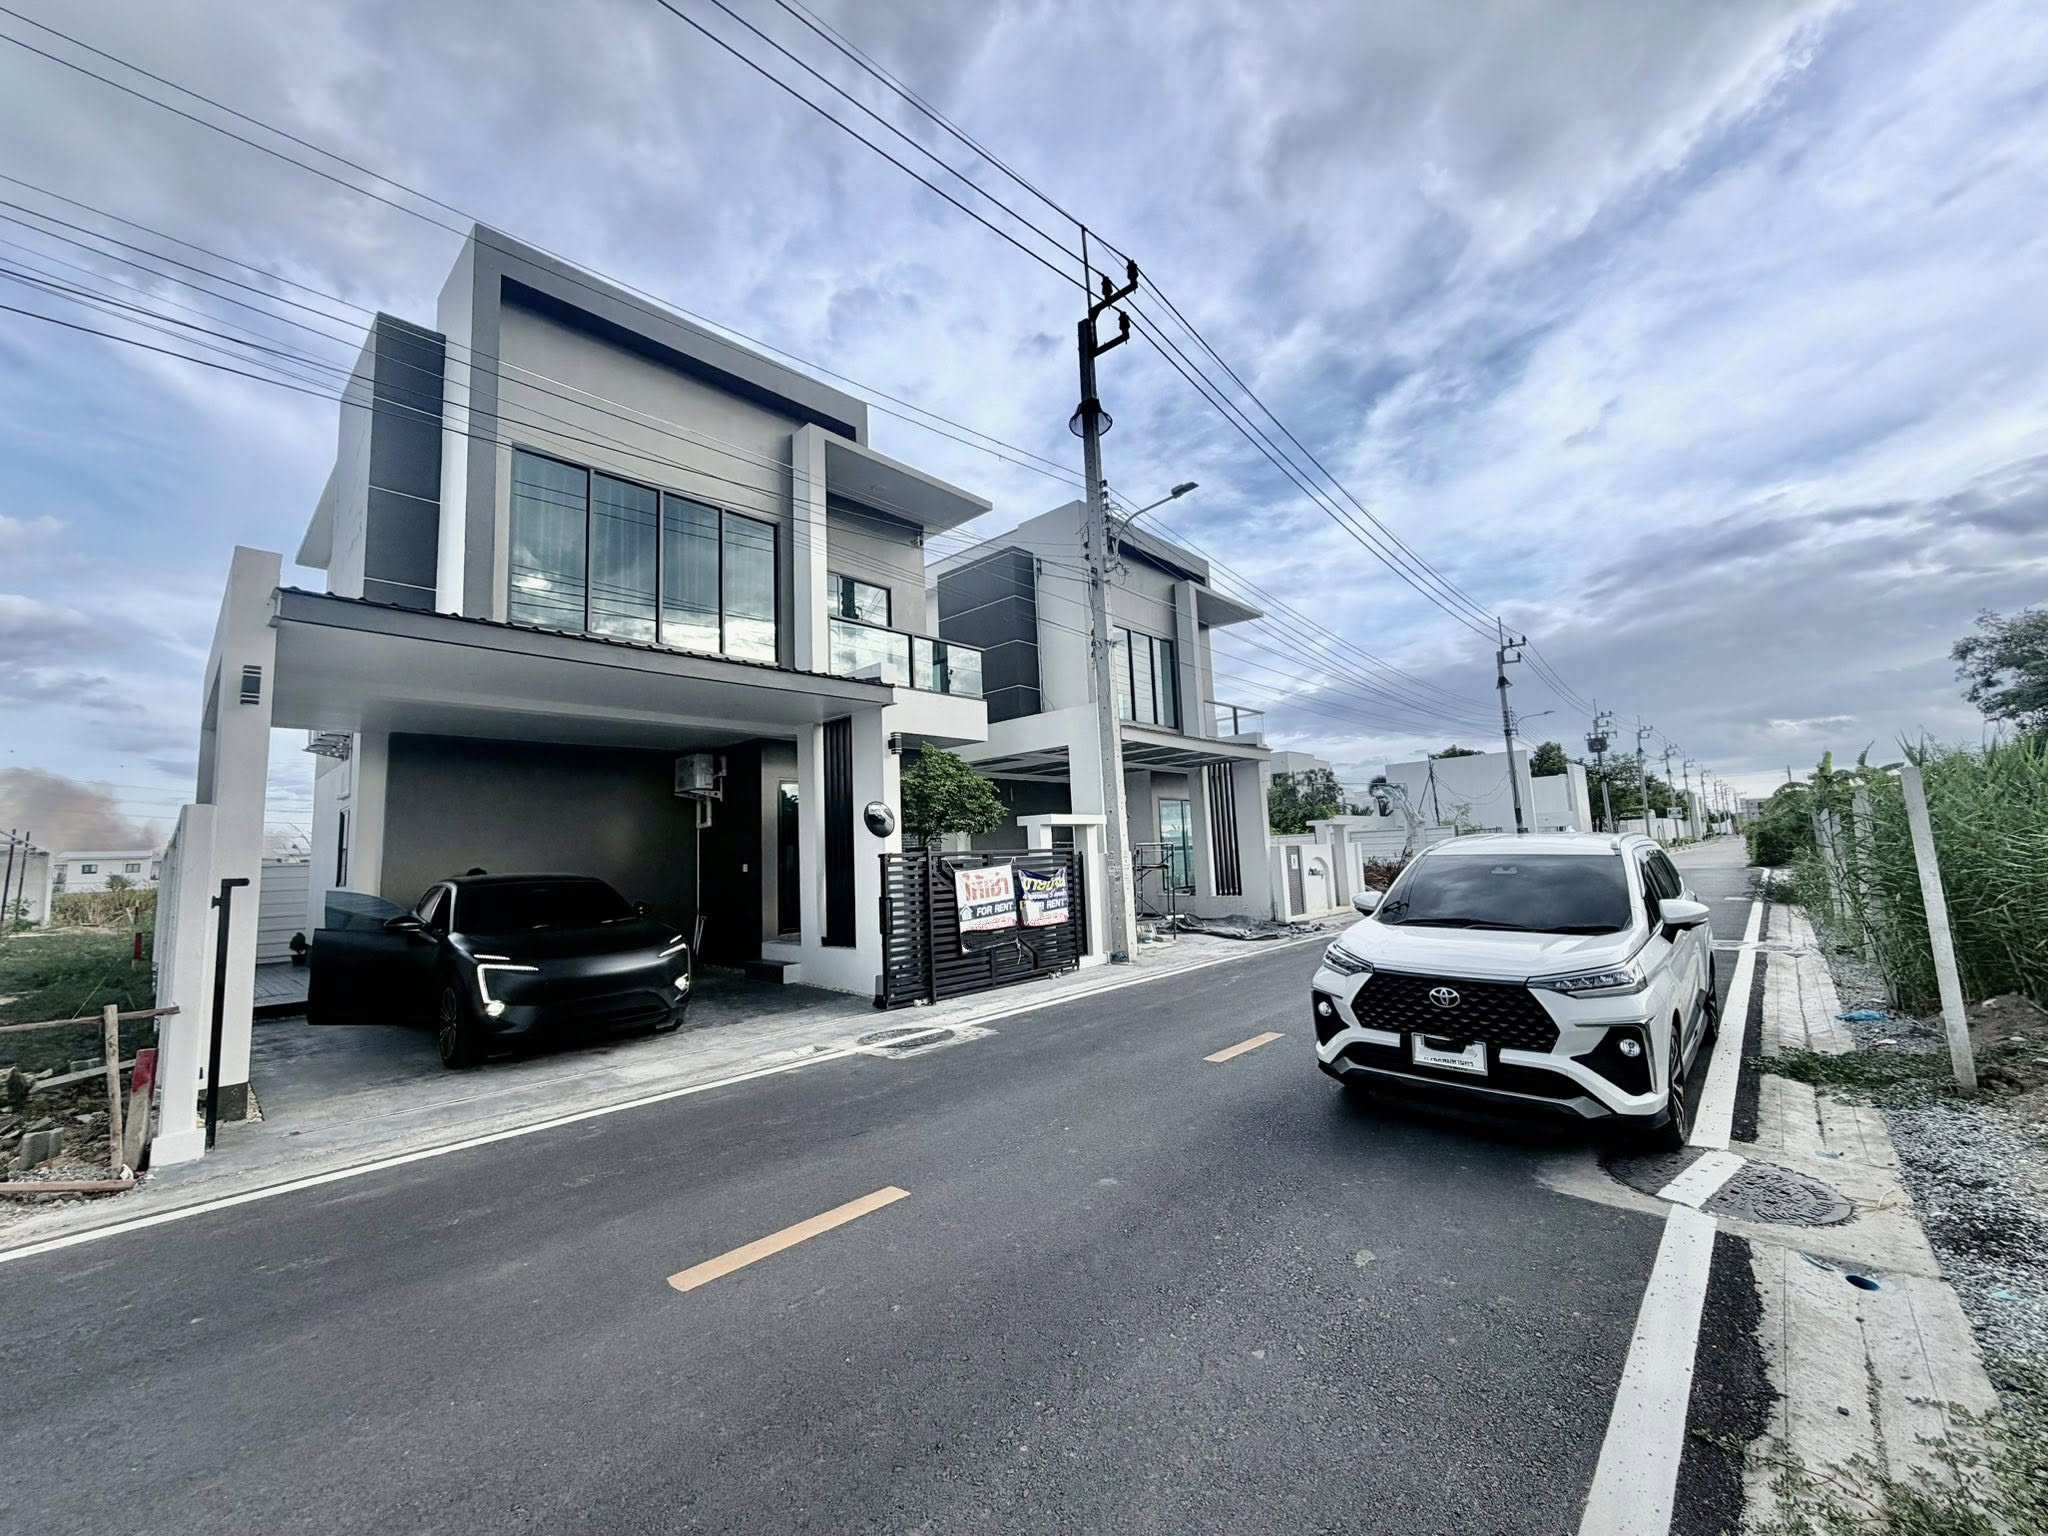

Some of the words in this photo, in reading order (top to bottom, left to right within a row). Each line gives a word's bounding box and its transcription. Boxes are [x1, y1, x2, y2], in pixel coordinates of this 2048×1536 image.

[976, 905, 993, 917] FOR
[995, 902, 1014, 913] RENT
[1047, 898, 1066, 910] RENT
